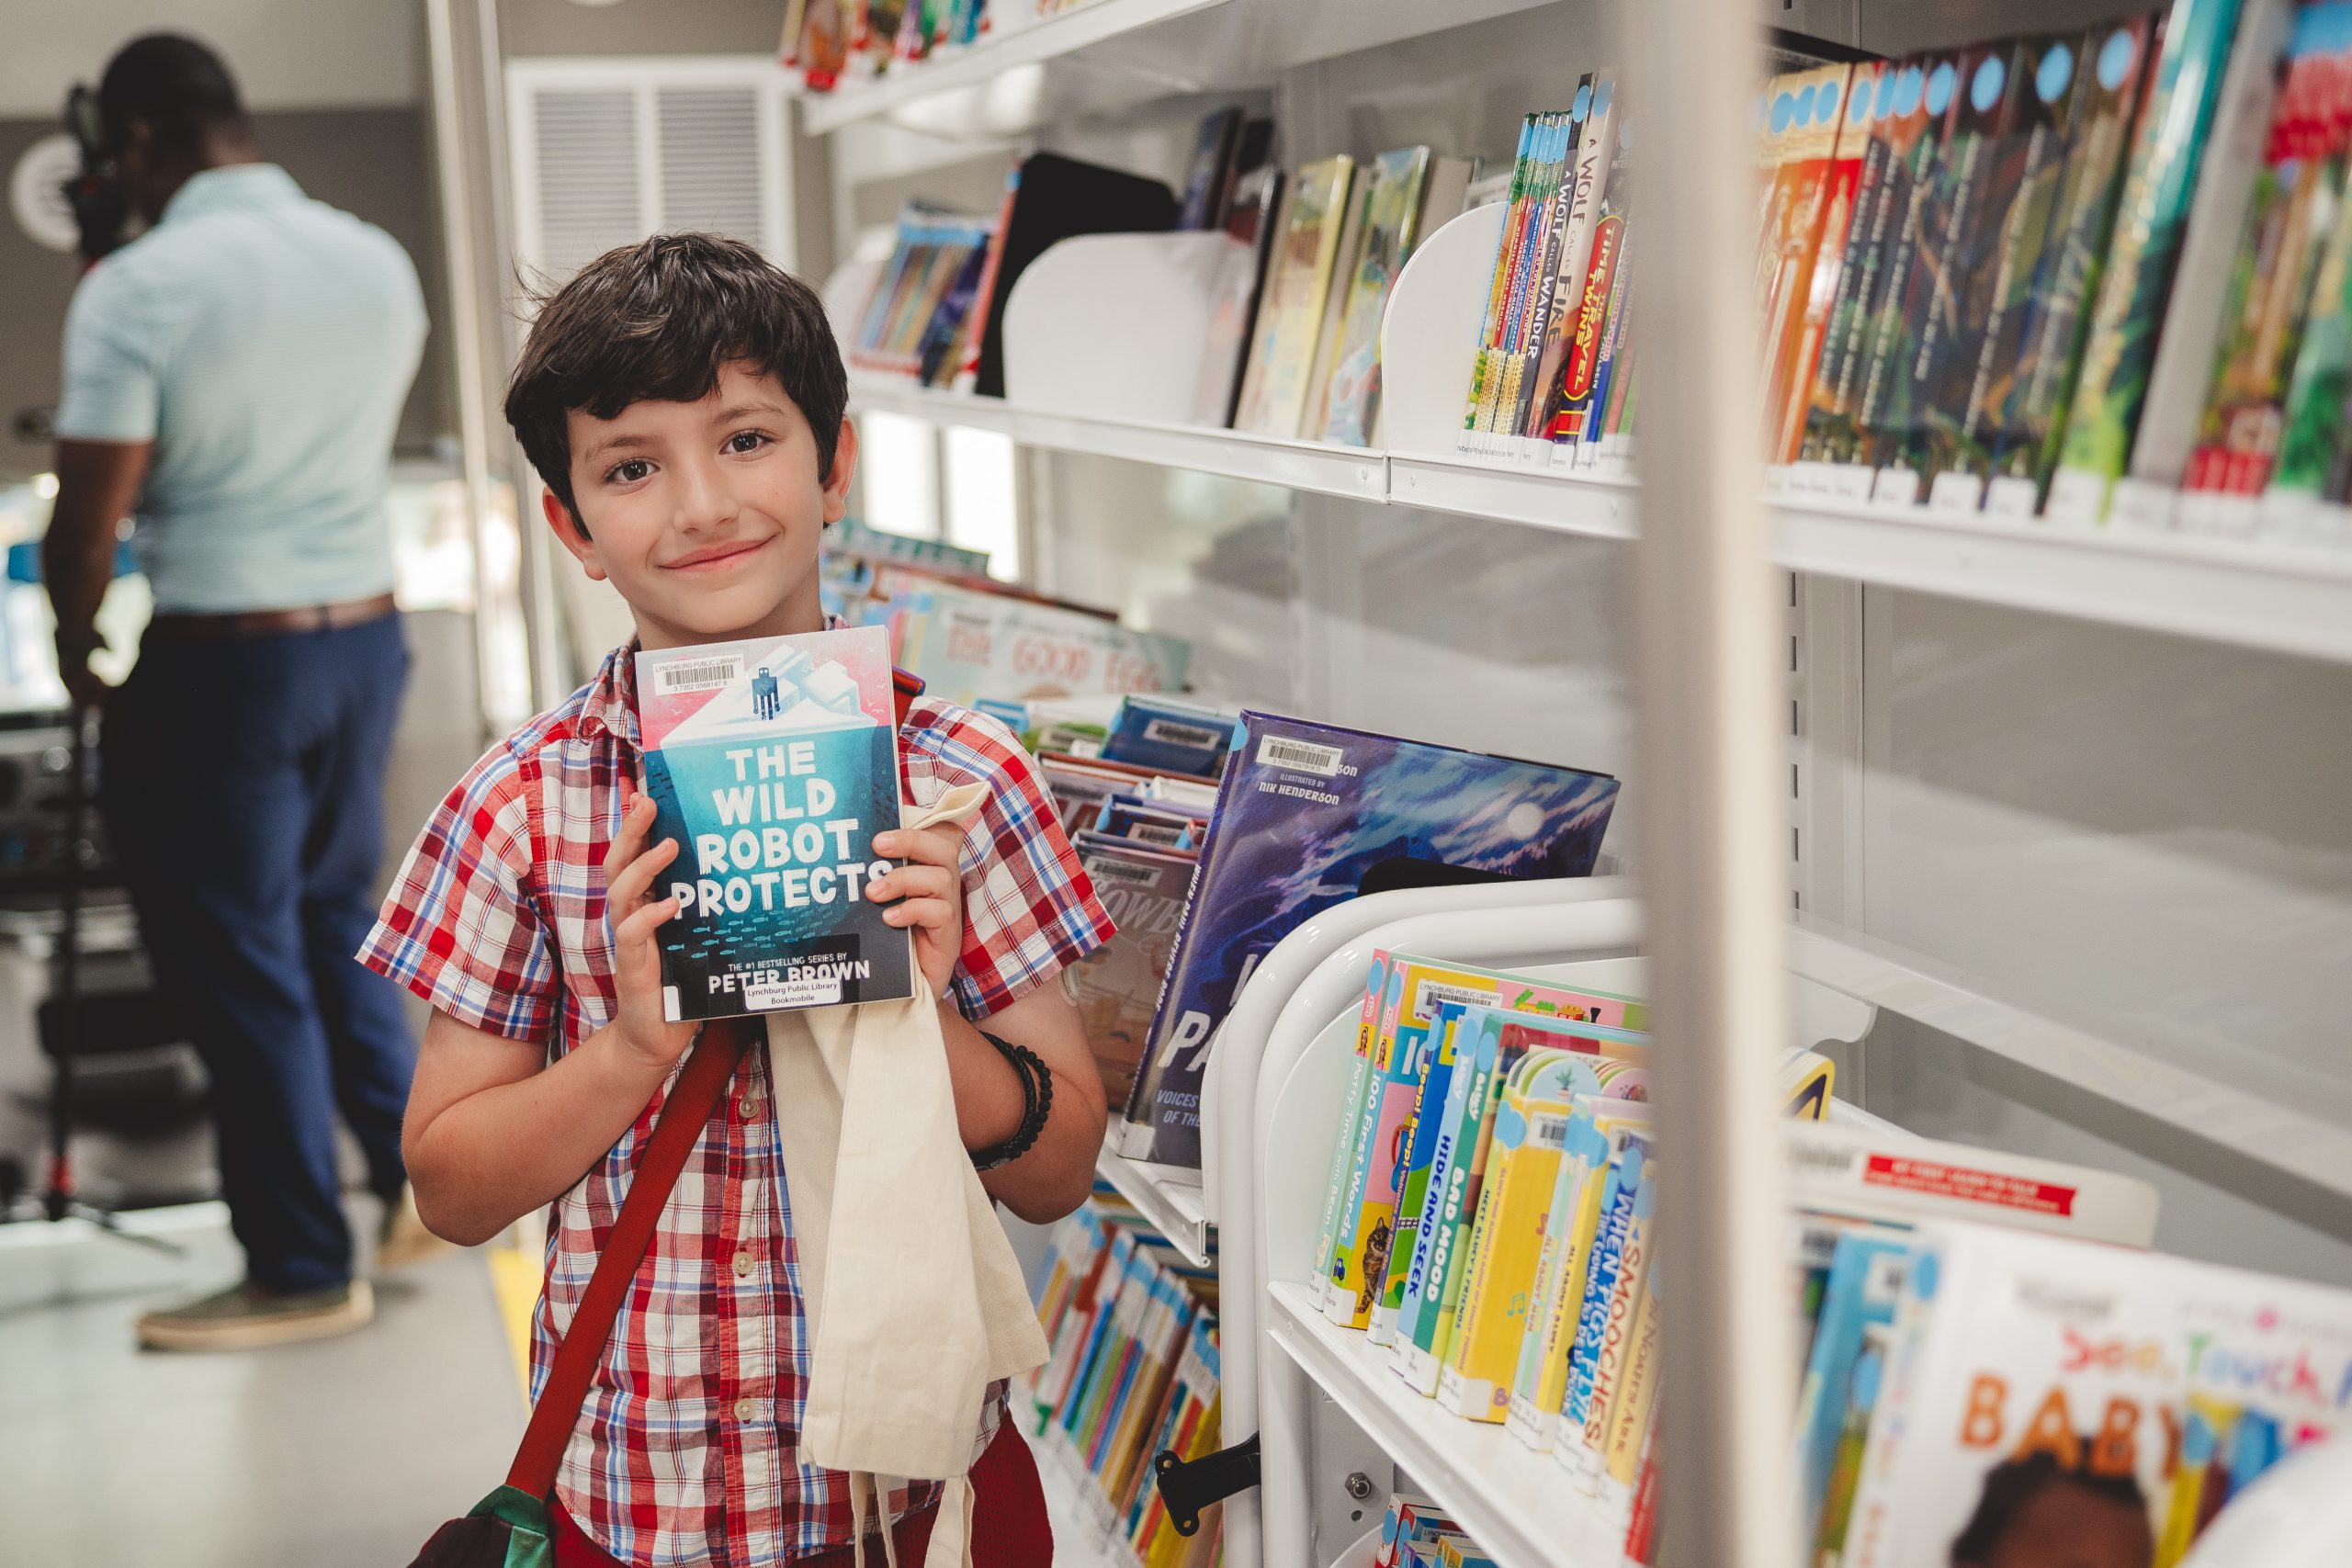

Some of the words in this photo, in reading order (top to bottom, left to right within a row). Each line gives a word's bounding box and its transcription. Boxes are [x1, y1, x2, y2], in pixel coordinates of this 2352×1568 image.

[1587, 138, 1597, 148] A
[1564, 170, 1571, 178] A
[1570, 152, 1597, 225] WOLF
[1549, 182, 1570, 239] WOLF
[1563, 230, 1577, 269] CALLED
[1595, 226, 1614, 284] TIME
[1526, 275, 1553, 359] WANDER
[1544, 273, 1573, 354] FIRE
[1575, 267, 1597, 346] TWINS
[1595, 293, 1605, 322] THE
[1573, 291, 1600, 390] TRAVEL
[655, 663, 693, 672] LYNCHBURG
[694, 660, 716, 668] PUBLIC
[717, 657, 741, 666] LIBRARY
[726, 740, 816, 782] THE
[1263, 739, 1296, 749] LYNCHBURG
[1297, 744, 1317, 752] PUBLIC
[1317, 747, 1340, 756] LIBRARY
[711, 778, 836, 826] WILD
[1259, 782, 1277, 794] NIK
[1278, 784, 1340, 806] HENDERSON
[1280, 773, 1317, 786] ILLUSTRATED
[696, 818, 859, 874] ROBOT
[671, 860, 893, 919] PROTECTS
[708, 969, 780, 994] PETER
[787, 960, 871, 983] BROWN
[728, 963, 743, 972] THE
[745, 962, 755, 970] #1
[757, 956, 806, 969] BESTSELLING
[808, 953, 835, 964] SERIES
[836, 952, 847, 961] BY
[747, 984, 786, 997] Lynchburg
[787, 982, 810, 993] Public
[811, 981, 838, 992] Library
[771, 994, 815, 1005] Bookmobile
[1419, 983, 1455, 994] LYNCHBURG
[1455, 988, 1476, 998] PUBLIC
[1476, 992, 1501, 1001] LIBRARY
[1157, 1089, 1200, 1106] VOICES
[1345, 1062, 1363, 1105] Potty
[1364, 1073, 1381, 1110] 100
[1163, 1110, 1180, 1123] OF
[1339, 1110, 1353, 1149] Time
[1353, 1113, 1373, 1165] First
[1332, 1154, 1344, 1180] with
[1434, 1134, 1451, 1189] HIDE
[1323, 1184, 1339, 1225] Bean
[1340, 1169, 1363, 1239] Words
[1422, 1190, 1439, 1238] AND
[1445, 1167, 1465, 1222] BAD
[1476, 1188, 1492, 1222] MEET
[1599, 1190, 1634, 1275] WHEN
[1408, 1241, 1428, 1298] SEEK
[1427, 1224, 1452, 1302] MOOD
[1581, 1239, 1604, 1298] GOING
[1453, 1278, 1473, 1329] FRIENDS
[1584, 1279, 1613, 1351] PIGS
[1579, 1242, 1643, 1451] SMOOCHES!
